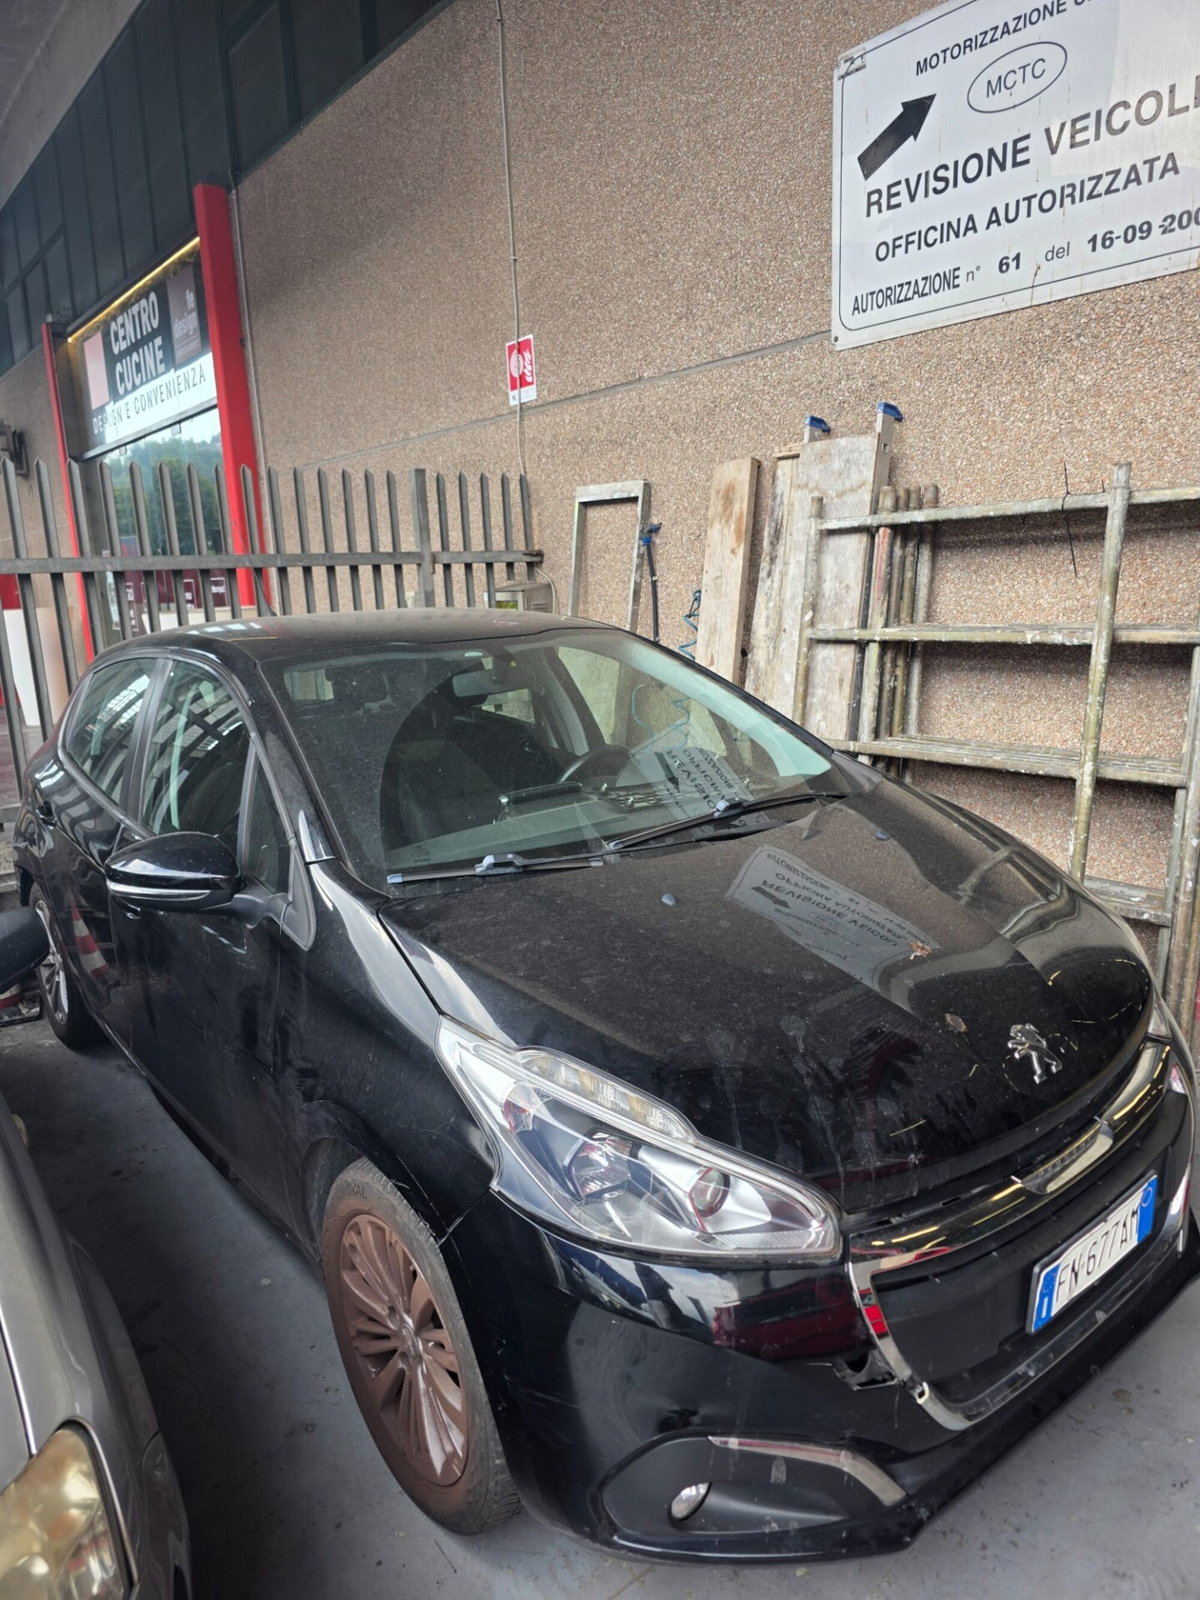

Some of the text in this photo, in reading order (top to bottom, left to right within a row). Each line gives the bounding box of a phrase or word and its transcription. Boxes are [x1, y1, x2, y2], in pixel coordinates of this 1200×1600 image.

[916, 0, 1067, 76] MOTORIZZAZIONE
[986, 58, 1046, 98] MCTC
[866, 134, 1031, 217] REVISIONE
[876, 152, 1180, 262] OFFICINA AUTORIZZATA
[852, 267, 960, 316] AUTORIZZAZIONE
[998, 252, 1022, 274] 61
[1045, 242, 1070, 262] del
[110, 291, 160, 355] CENTRO
[93, 363, 206, 434] DESGN E CONVENIENZA
[115, 336, 166, 396] CUCINE
